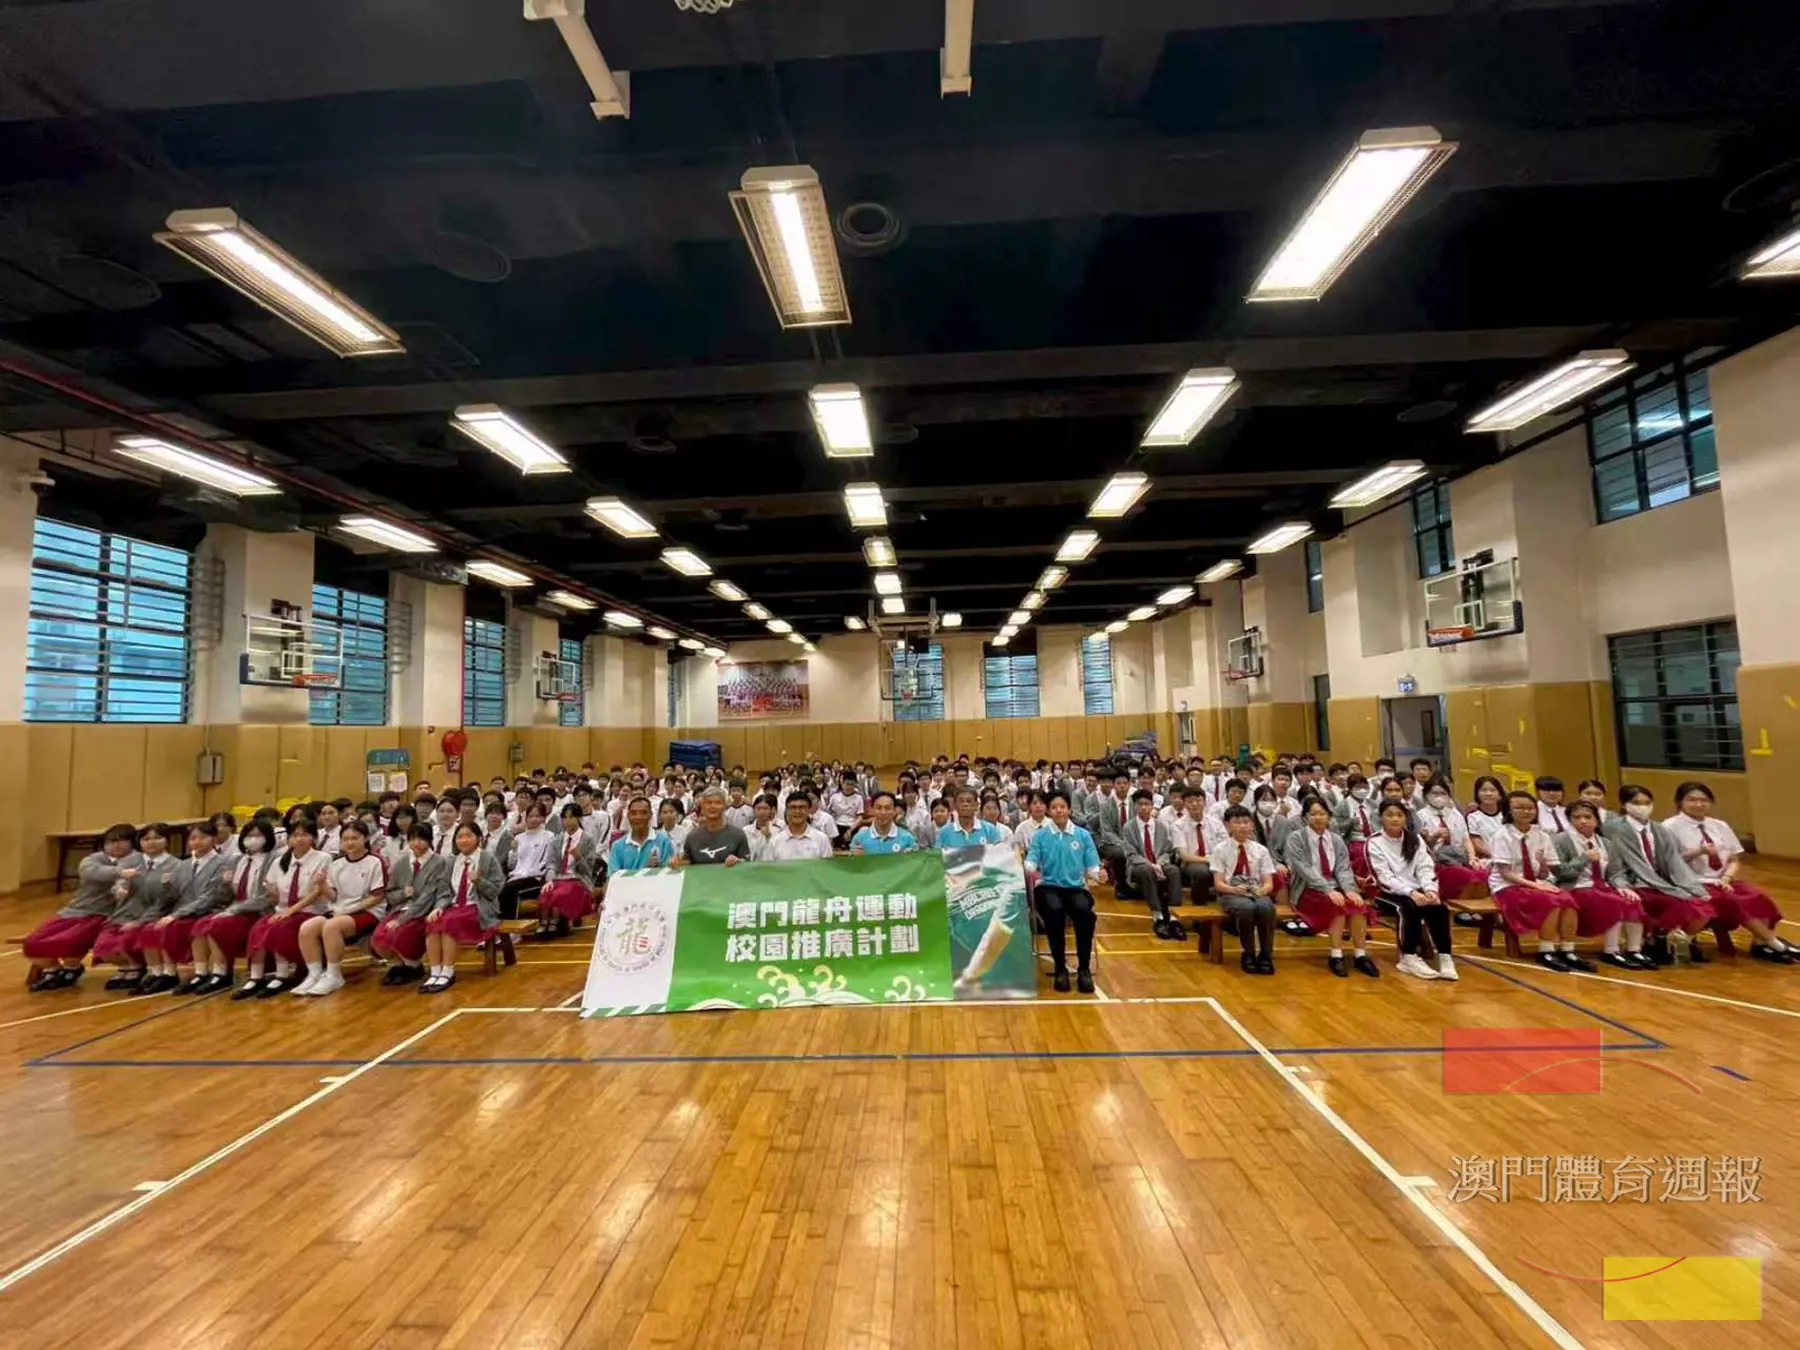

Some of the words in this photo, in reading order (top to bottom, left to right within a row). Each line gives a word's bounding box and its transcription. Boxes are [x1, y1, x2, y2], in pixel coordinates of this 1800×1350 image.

[727, 893, 917, 929] 澳門龍舟運動
[726, 925, 920, 963] 校園推廣計劃
